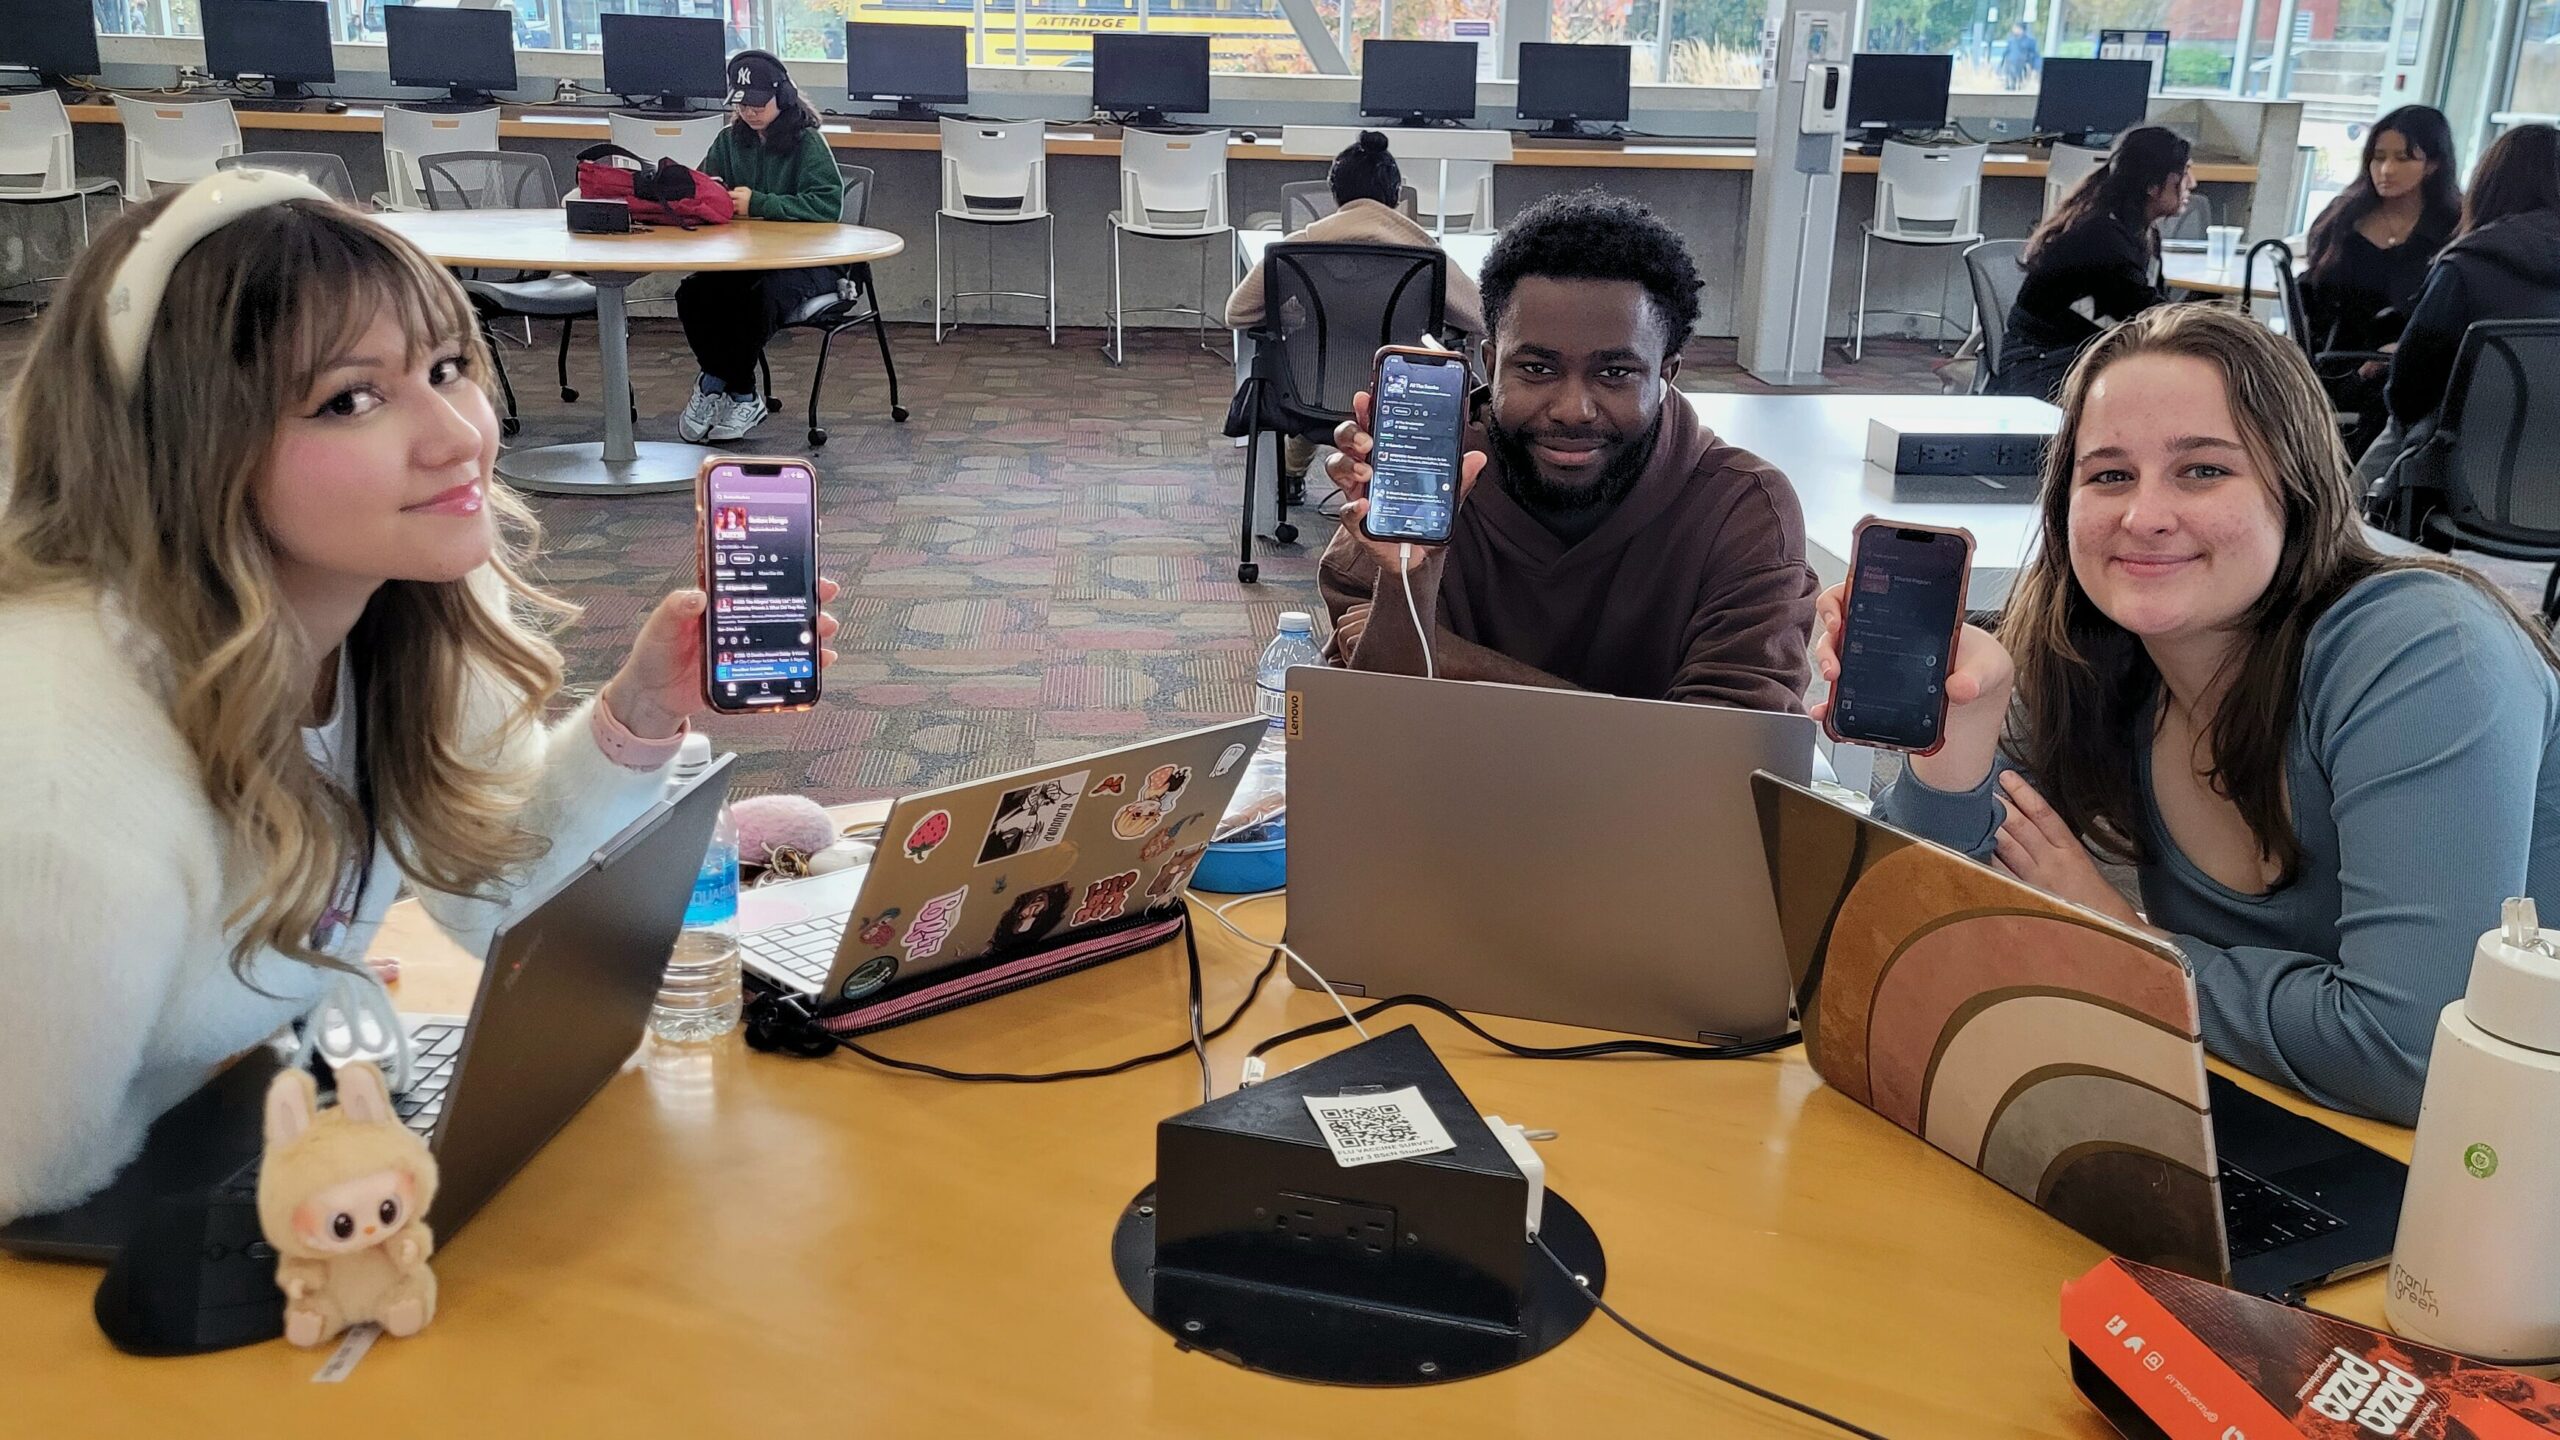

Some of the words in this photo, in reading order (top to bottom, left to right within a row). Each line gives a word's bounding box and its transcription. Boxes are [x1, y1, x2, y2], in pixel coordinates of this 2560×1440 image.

[1036, 17, 1126, 28] ATTRIDGE
[1289, 695, 1299, 736] Lenovo
[1355, 1143, 1396, 1154] VACCINE
[1398, 1139, 1434, 1149] SURVEY
[1399, 1145, 1440, 1156] Students
[2393, 1263, 2434, 1301] frank
[2395, 1280, 2439, 1318] green
[2307, 1346, 2381, 1422] pizza
[2355, 1359, 2426, 1435] pizza
